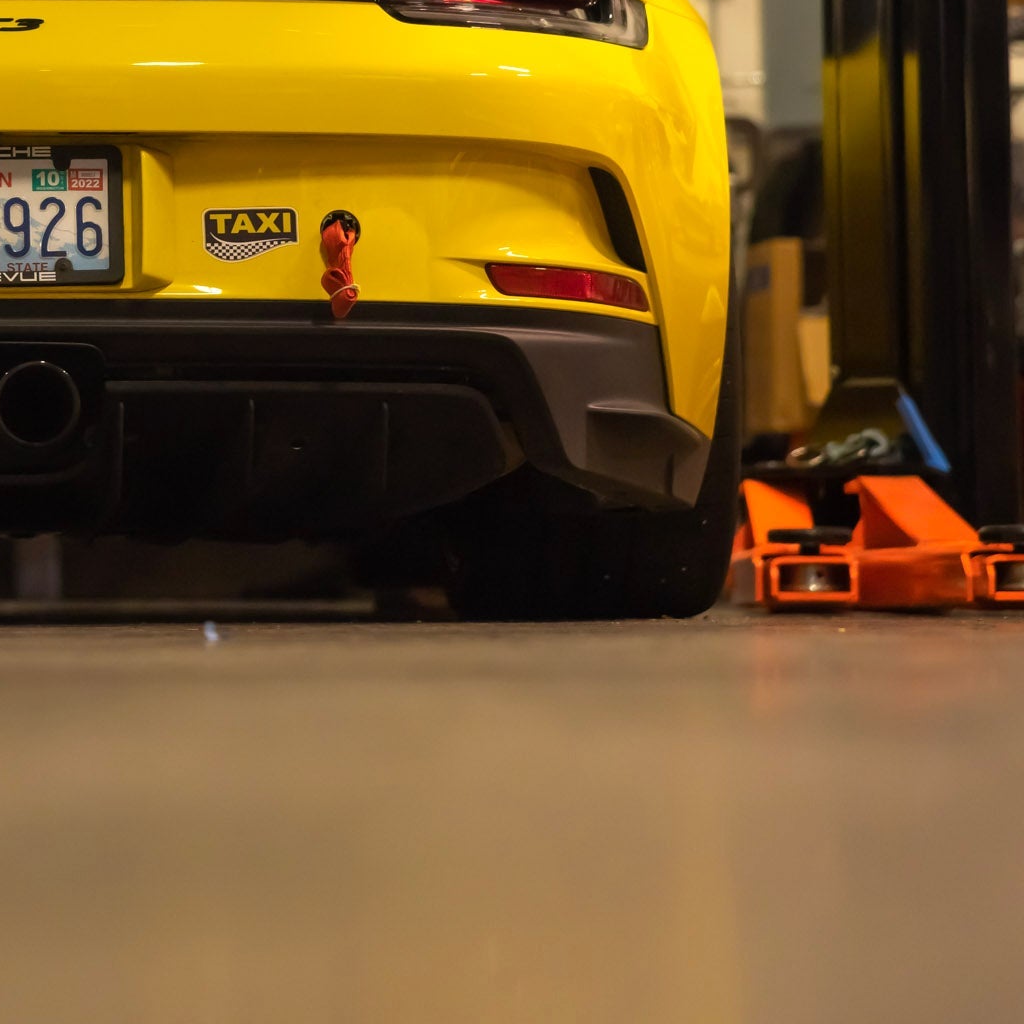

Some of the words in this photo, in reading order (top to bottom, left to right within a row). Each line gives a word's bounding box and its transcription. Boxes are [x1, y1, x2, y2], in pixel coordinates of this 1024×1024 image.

[36, 171, 60, 187] 10
[71, 179, 100, 188] 2022
[209, 212, 292, 234] TAXI
[7, 263, 48, 272] STATE
